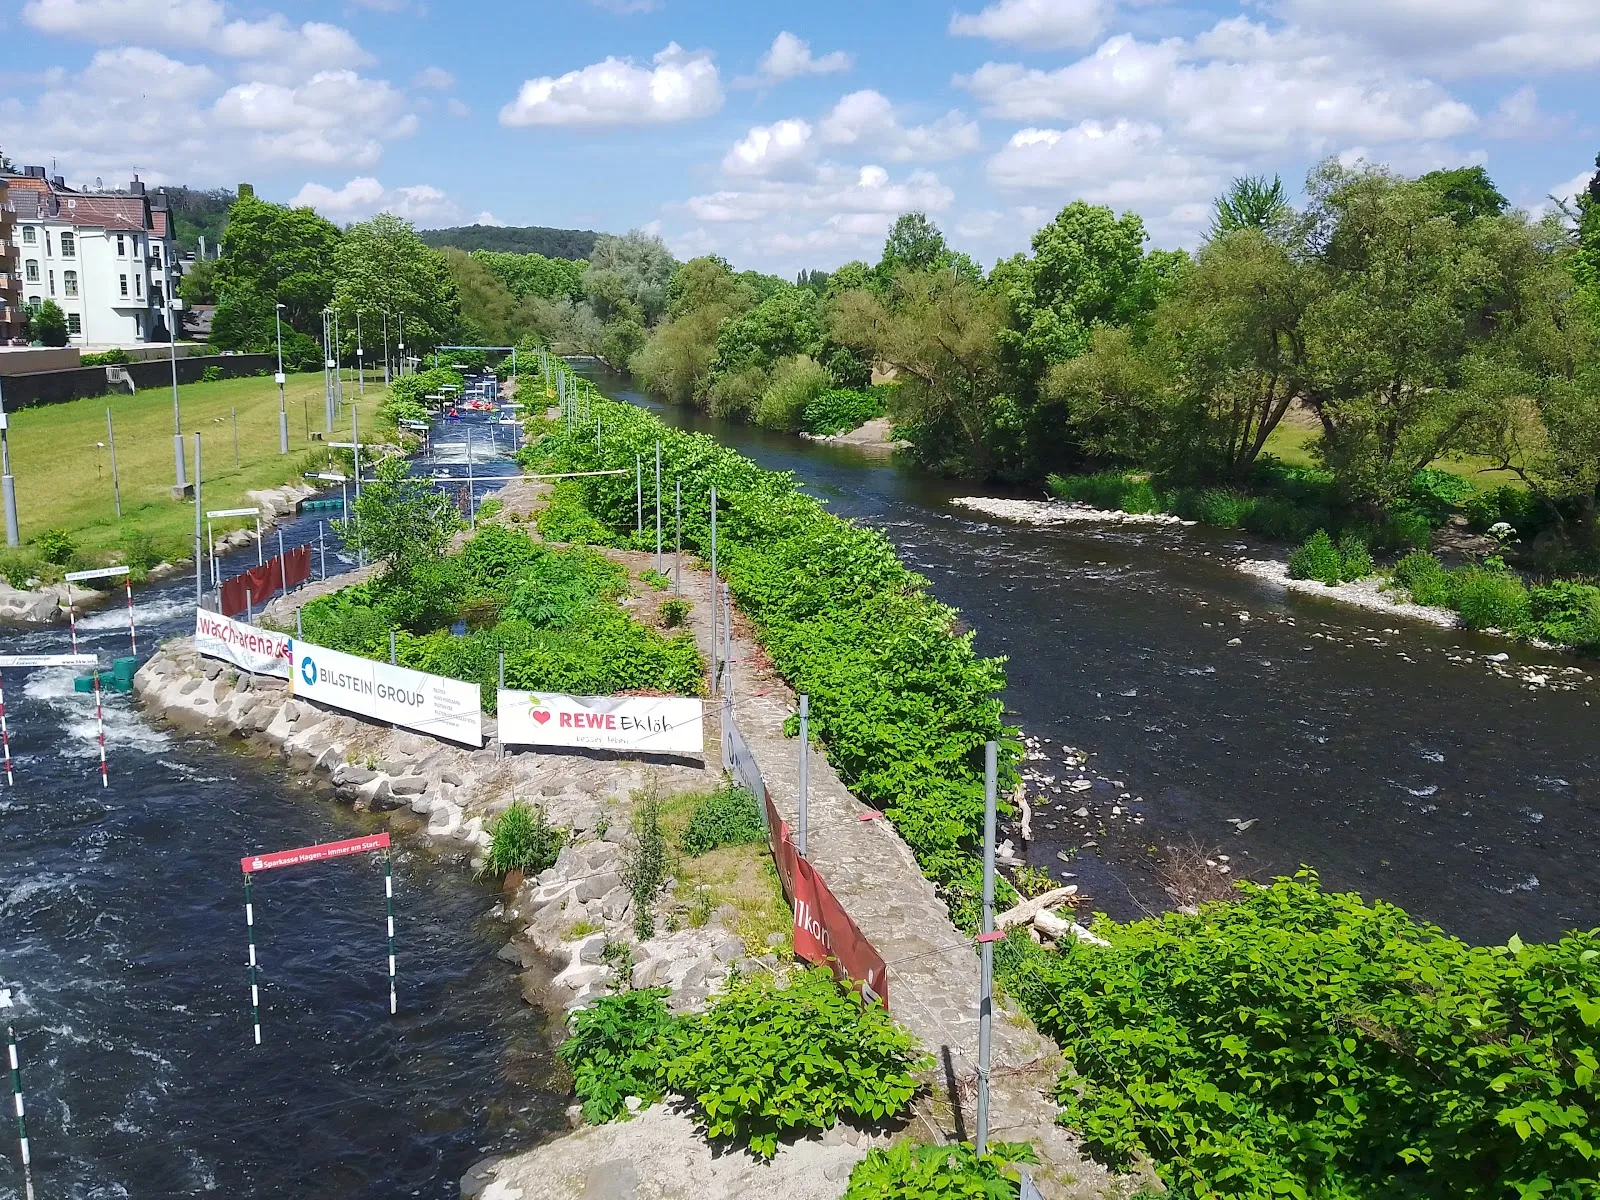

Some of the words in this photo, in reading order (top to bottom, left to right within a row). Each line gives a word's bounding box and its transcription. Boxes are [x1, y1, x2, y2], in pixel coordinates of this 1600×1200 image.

[320, 667, 372, 695] BILSTEIN
[377, 684, 425, 707] GROUP
[560, 713, 616, 731] REWE
[620, 715, 673, 733] Eklöh
[263, 857, 298, 868] Sparkasse
[299, 852, 321, 861] Hagen
[362, 840, 381, 849] Start.
